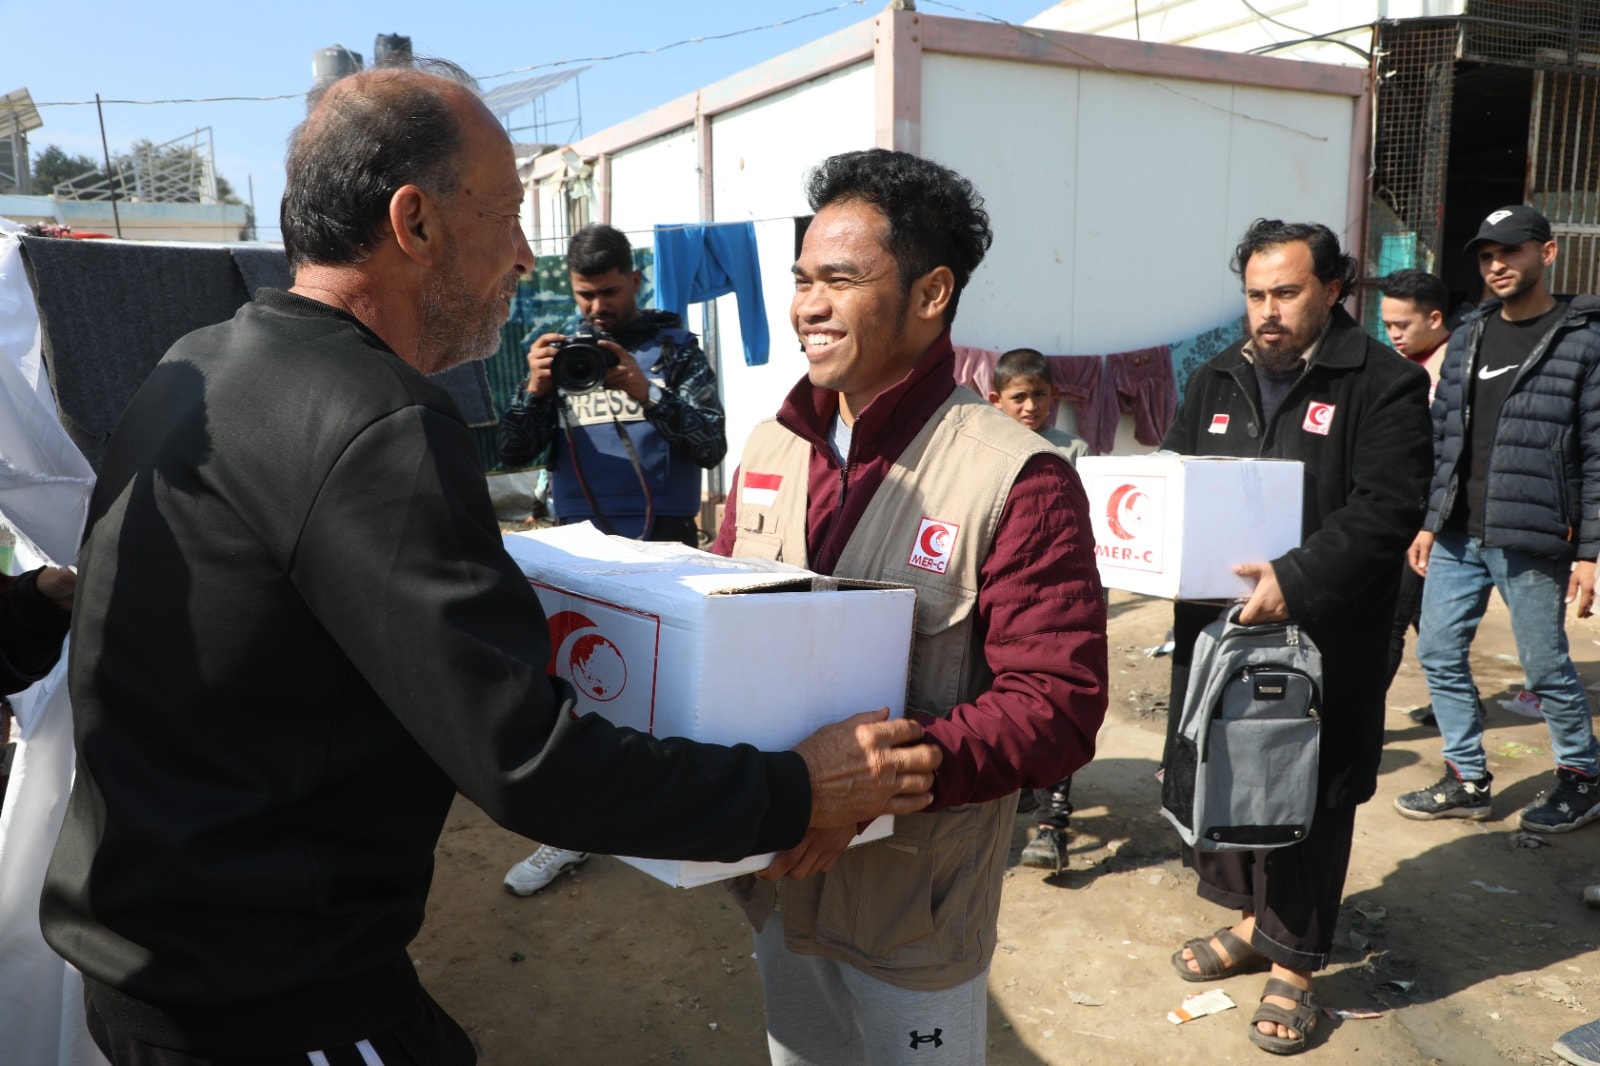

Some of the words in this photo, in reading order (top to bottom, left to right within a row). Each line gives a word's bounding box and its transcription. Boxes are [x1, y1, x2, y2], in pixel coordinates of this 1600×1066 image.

[567, 388, 641, 418] RESS
[911, 554, 945, 571] MER-C
[1095, 544, 1153, 564] MER-C
